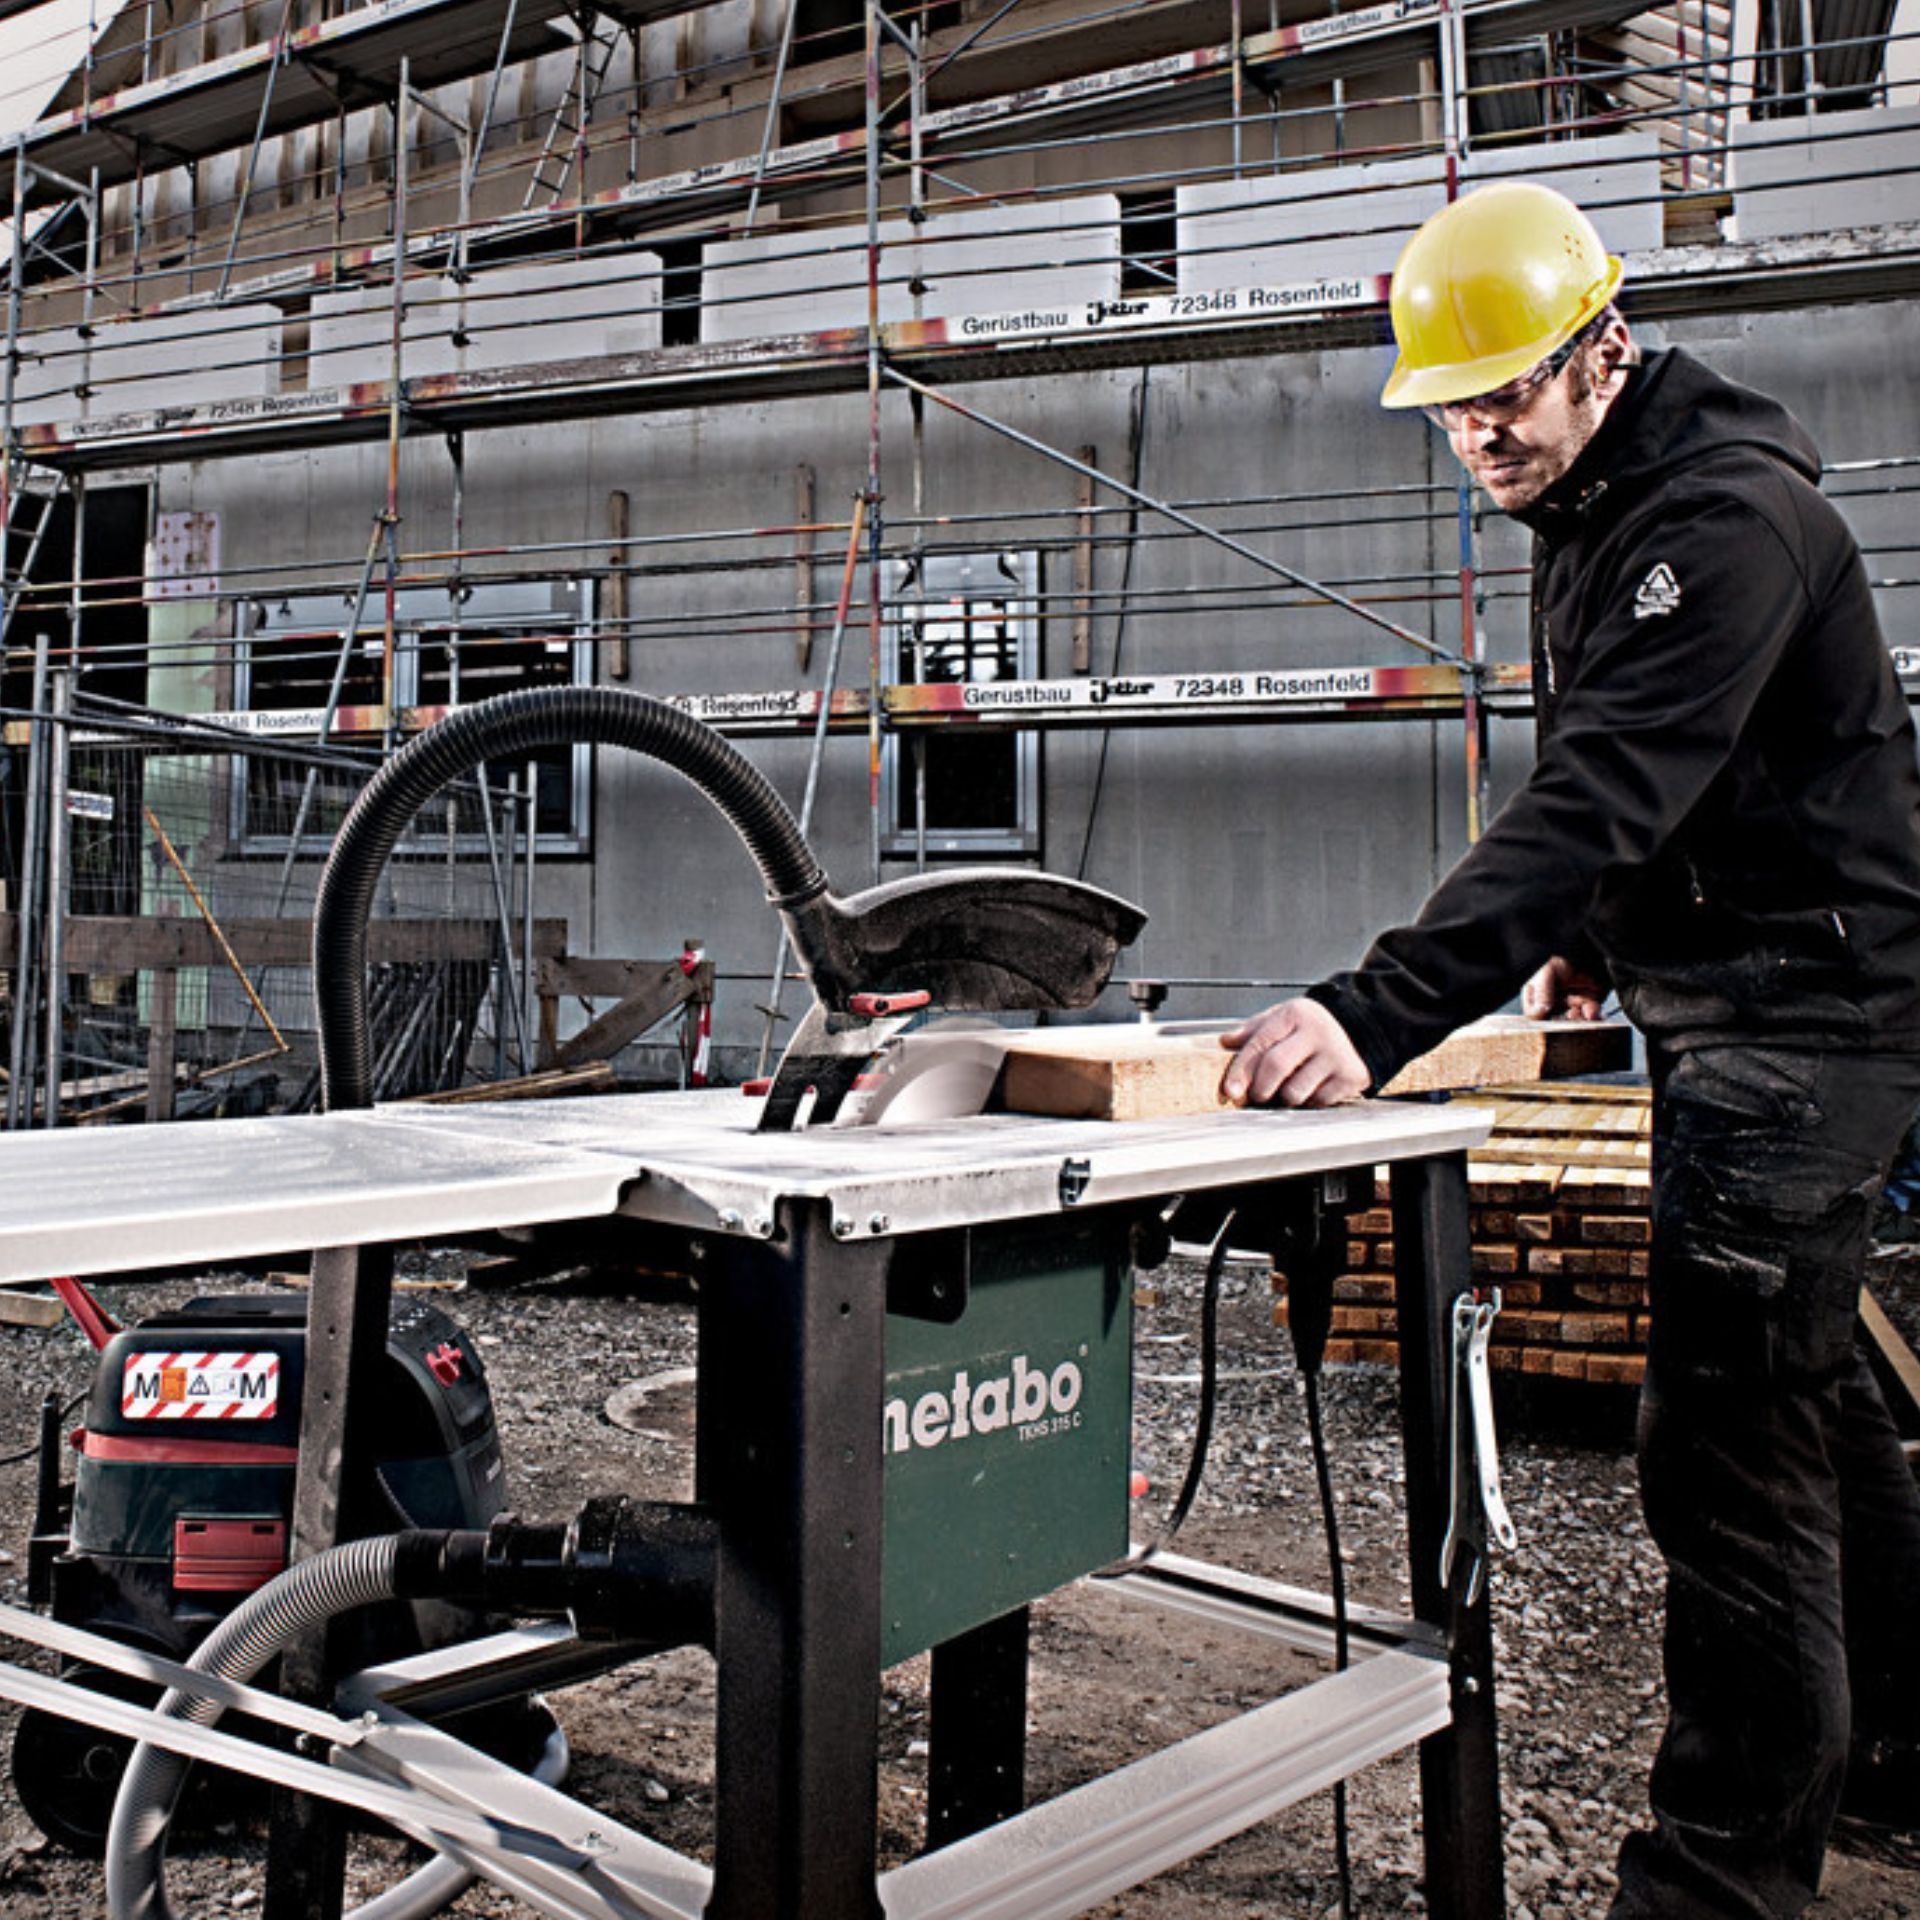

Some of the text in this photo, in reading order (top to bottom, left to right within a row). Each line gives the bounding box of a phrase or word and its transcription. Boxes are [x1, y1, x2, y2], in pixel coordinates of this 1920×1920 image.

[961, 311, 1069, 335] Gerüstbau
[1169, 292, 1237, 315] 72348
[1249, 281, 1362, 307] Rosenfeld
[964, 684, 1072, 706] Gerüstbau
[1173, 678, 1245, 698] 72348
[1256, 673, 1371, 697] Rosenfeld
[135, 1371, 267, 1399] M M
[1072, 1410, 1082, 1428] C
